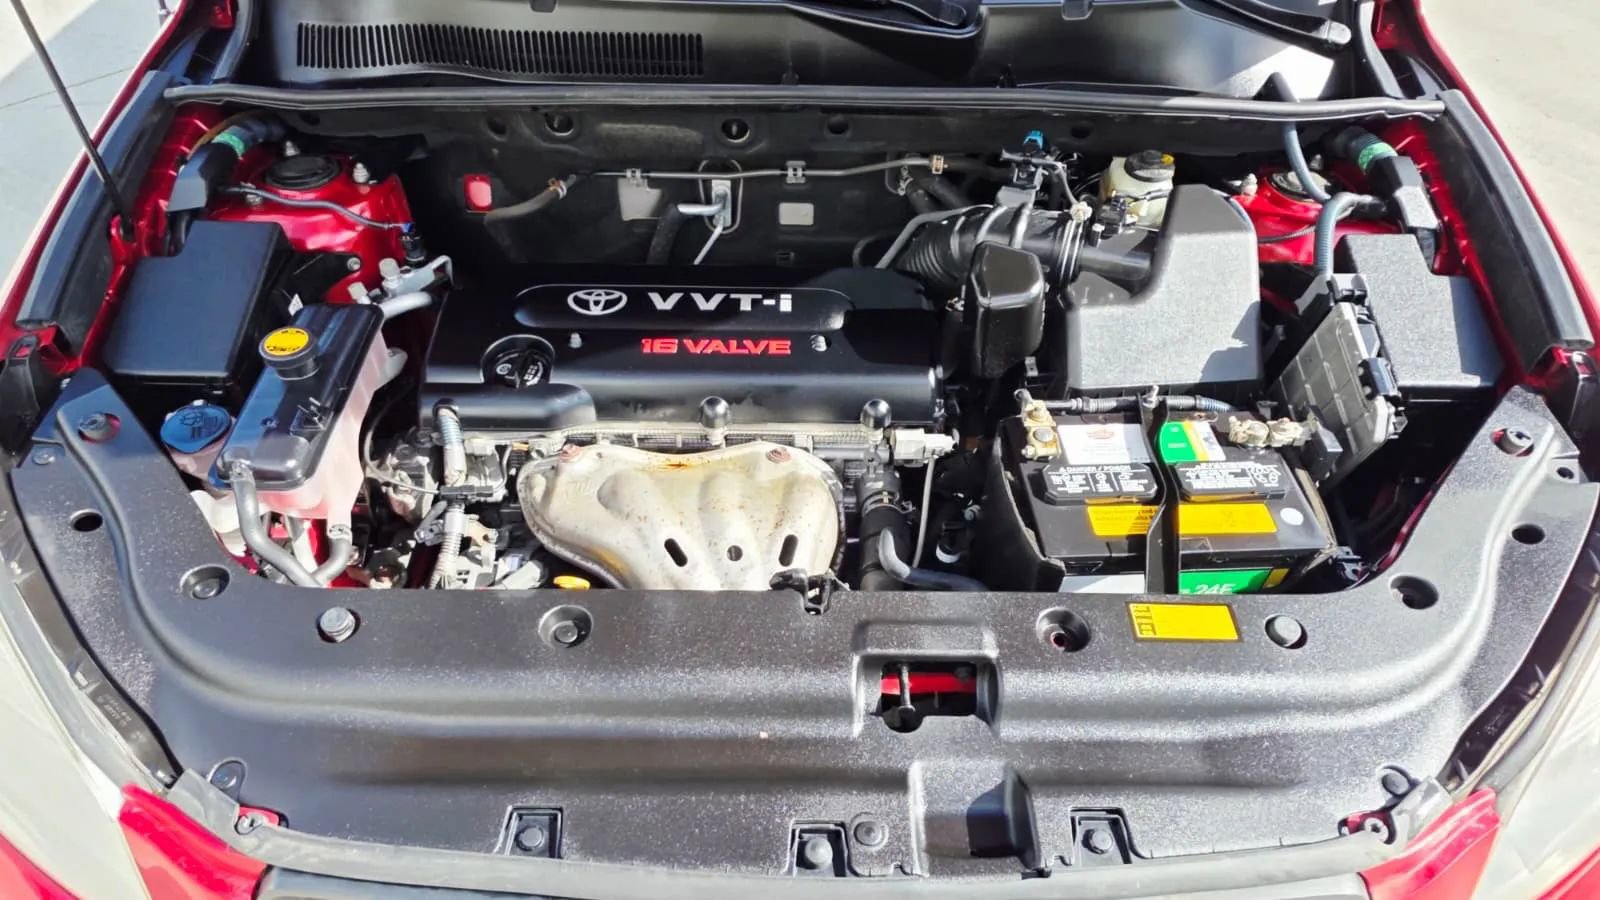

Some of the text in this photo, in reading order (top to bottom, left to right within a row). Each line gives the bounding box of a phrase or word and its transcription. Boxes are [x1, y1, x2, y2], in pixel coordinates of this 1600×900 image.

[647, 292, 793, 312] VVT-i
[641, 338, 792, 355] 16 VALVE
